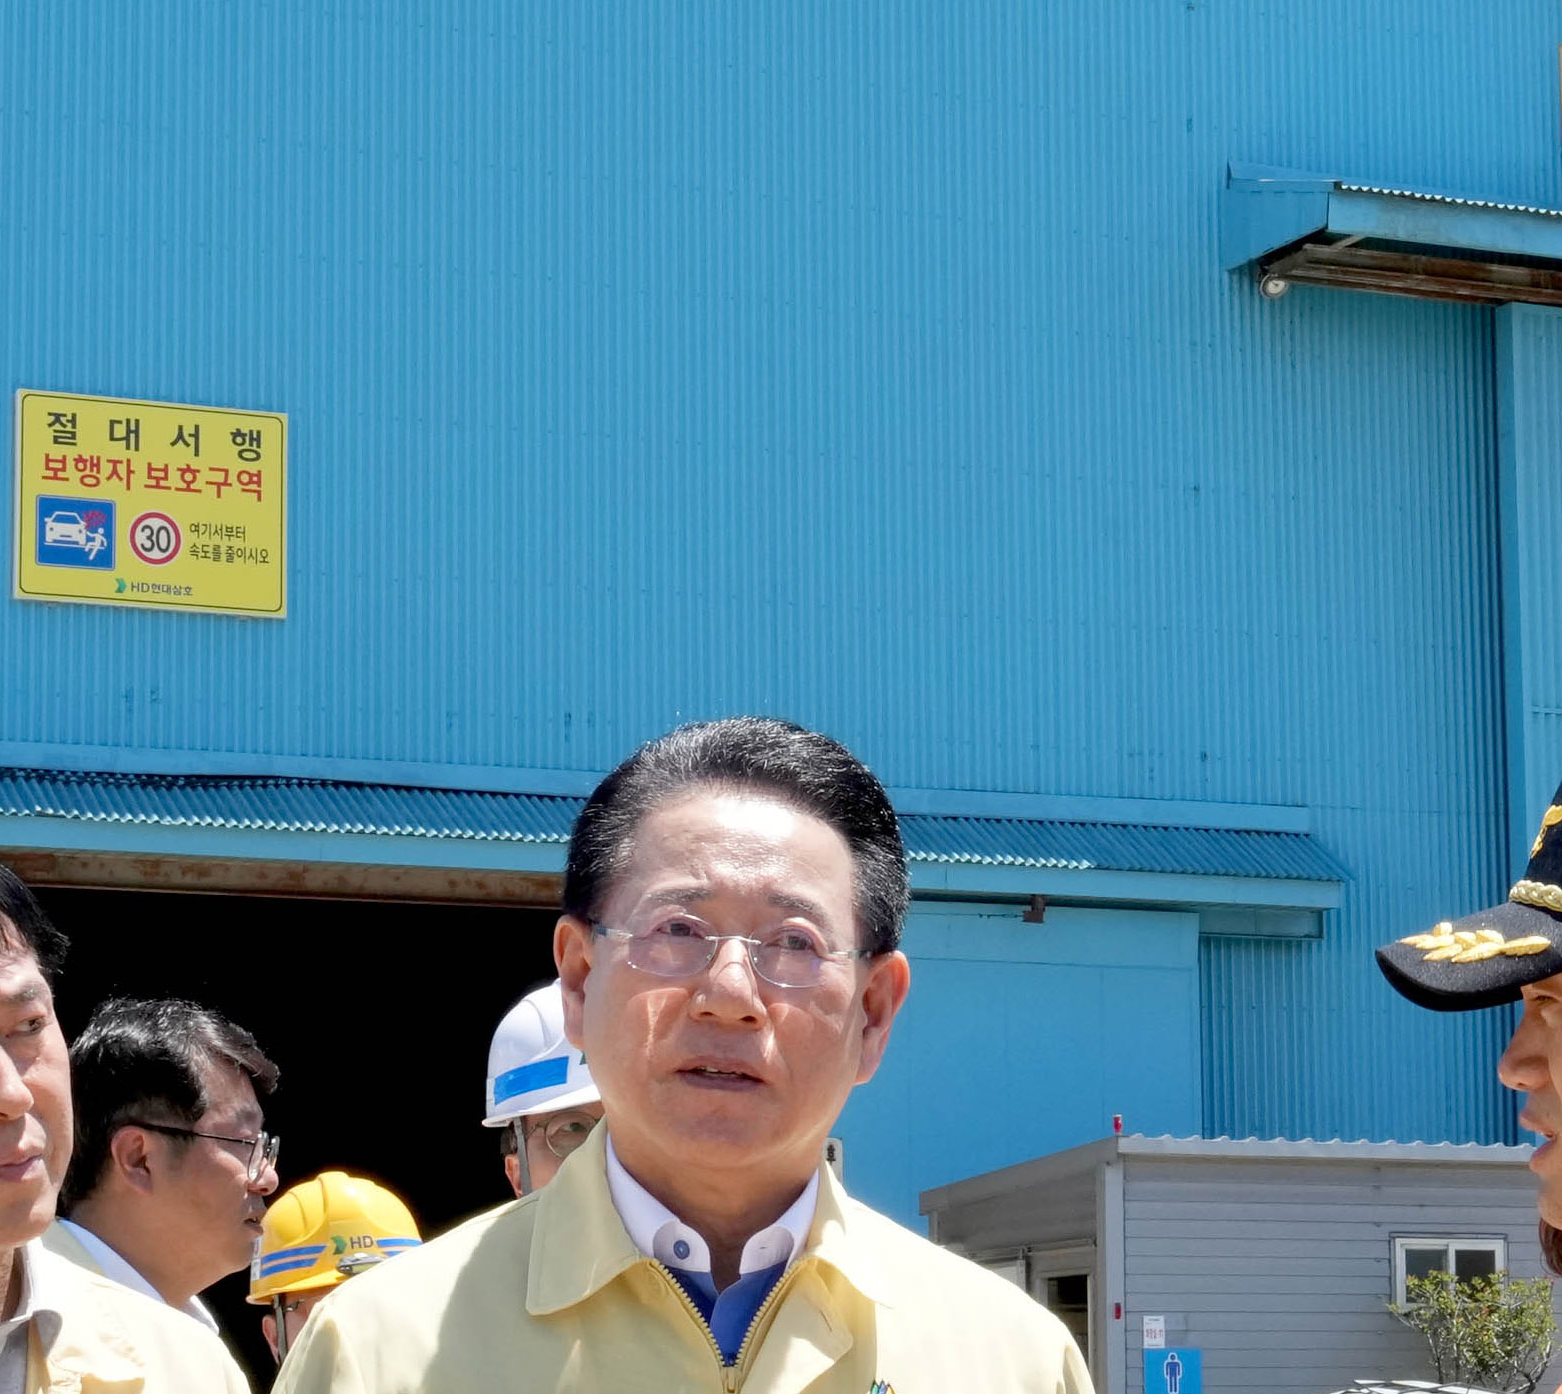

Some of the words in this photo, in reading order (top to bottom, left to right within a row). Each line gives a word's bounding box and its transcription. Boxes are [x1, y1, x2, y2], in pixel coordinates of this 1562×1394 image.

[41, 453, 135, 491] 보행자
[143, 462, 264, 502] 보호구역
[140, 524, 171, 554] 30
[189, 523, 246, 543] 여기서부터
[189, 543, 223, 562] 속도를
[225, 546, 270, 565] 줄이시오
[349, 1235, 374, 1250] HD
